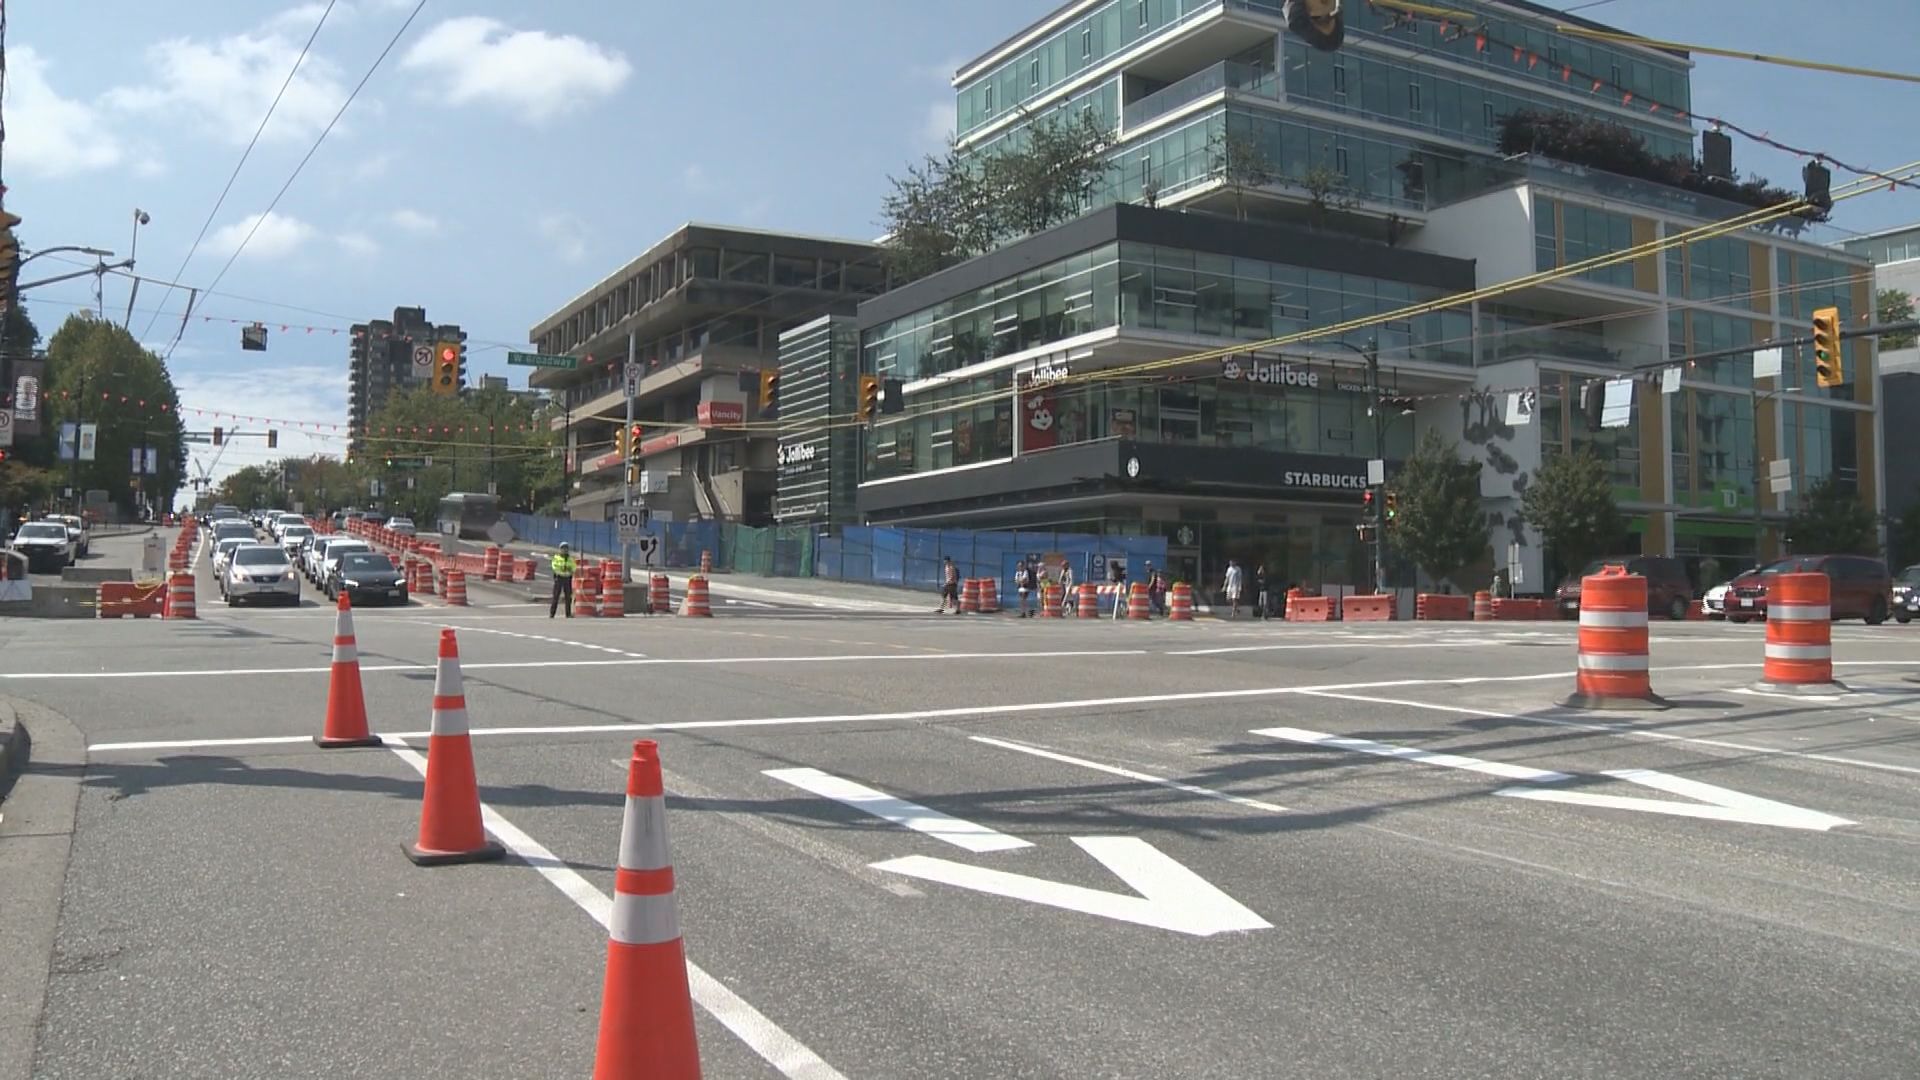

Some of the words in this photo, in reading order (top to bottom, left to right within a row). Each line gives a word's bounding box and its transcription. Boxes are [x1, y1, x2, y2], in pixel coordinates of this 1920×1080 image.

[1246, 360, 1319, 387] Jollibee
[711, 409, 741, 421] Vancity
[1284, 471, 1367, 489] STARBUCKS
[1720, 489, 1737, 508] TD
[619, 512, 638, 527] 30
